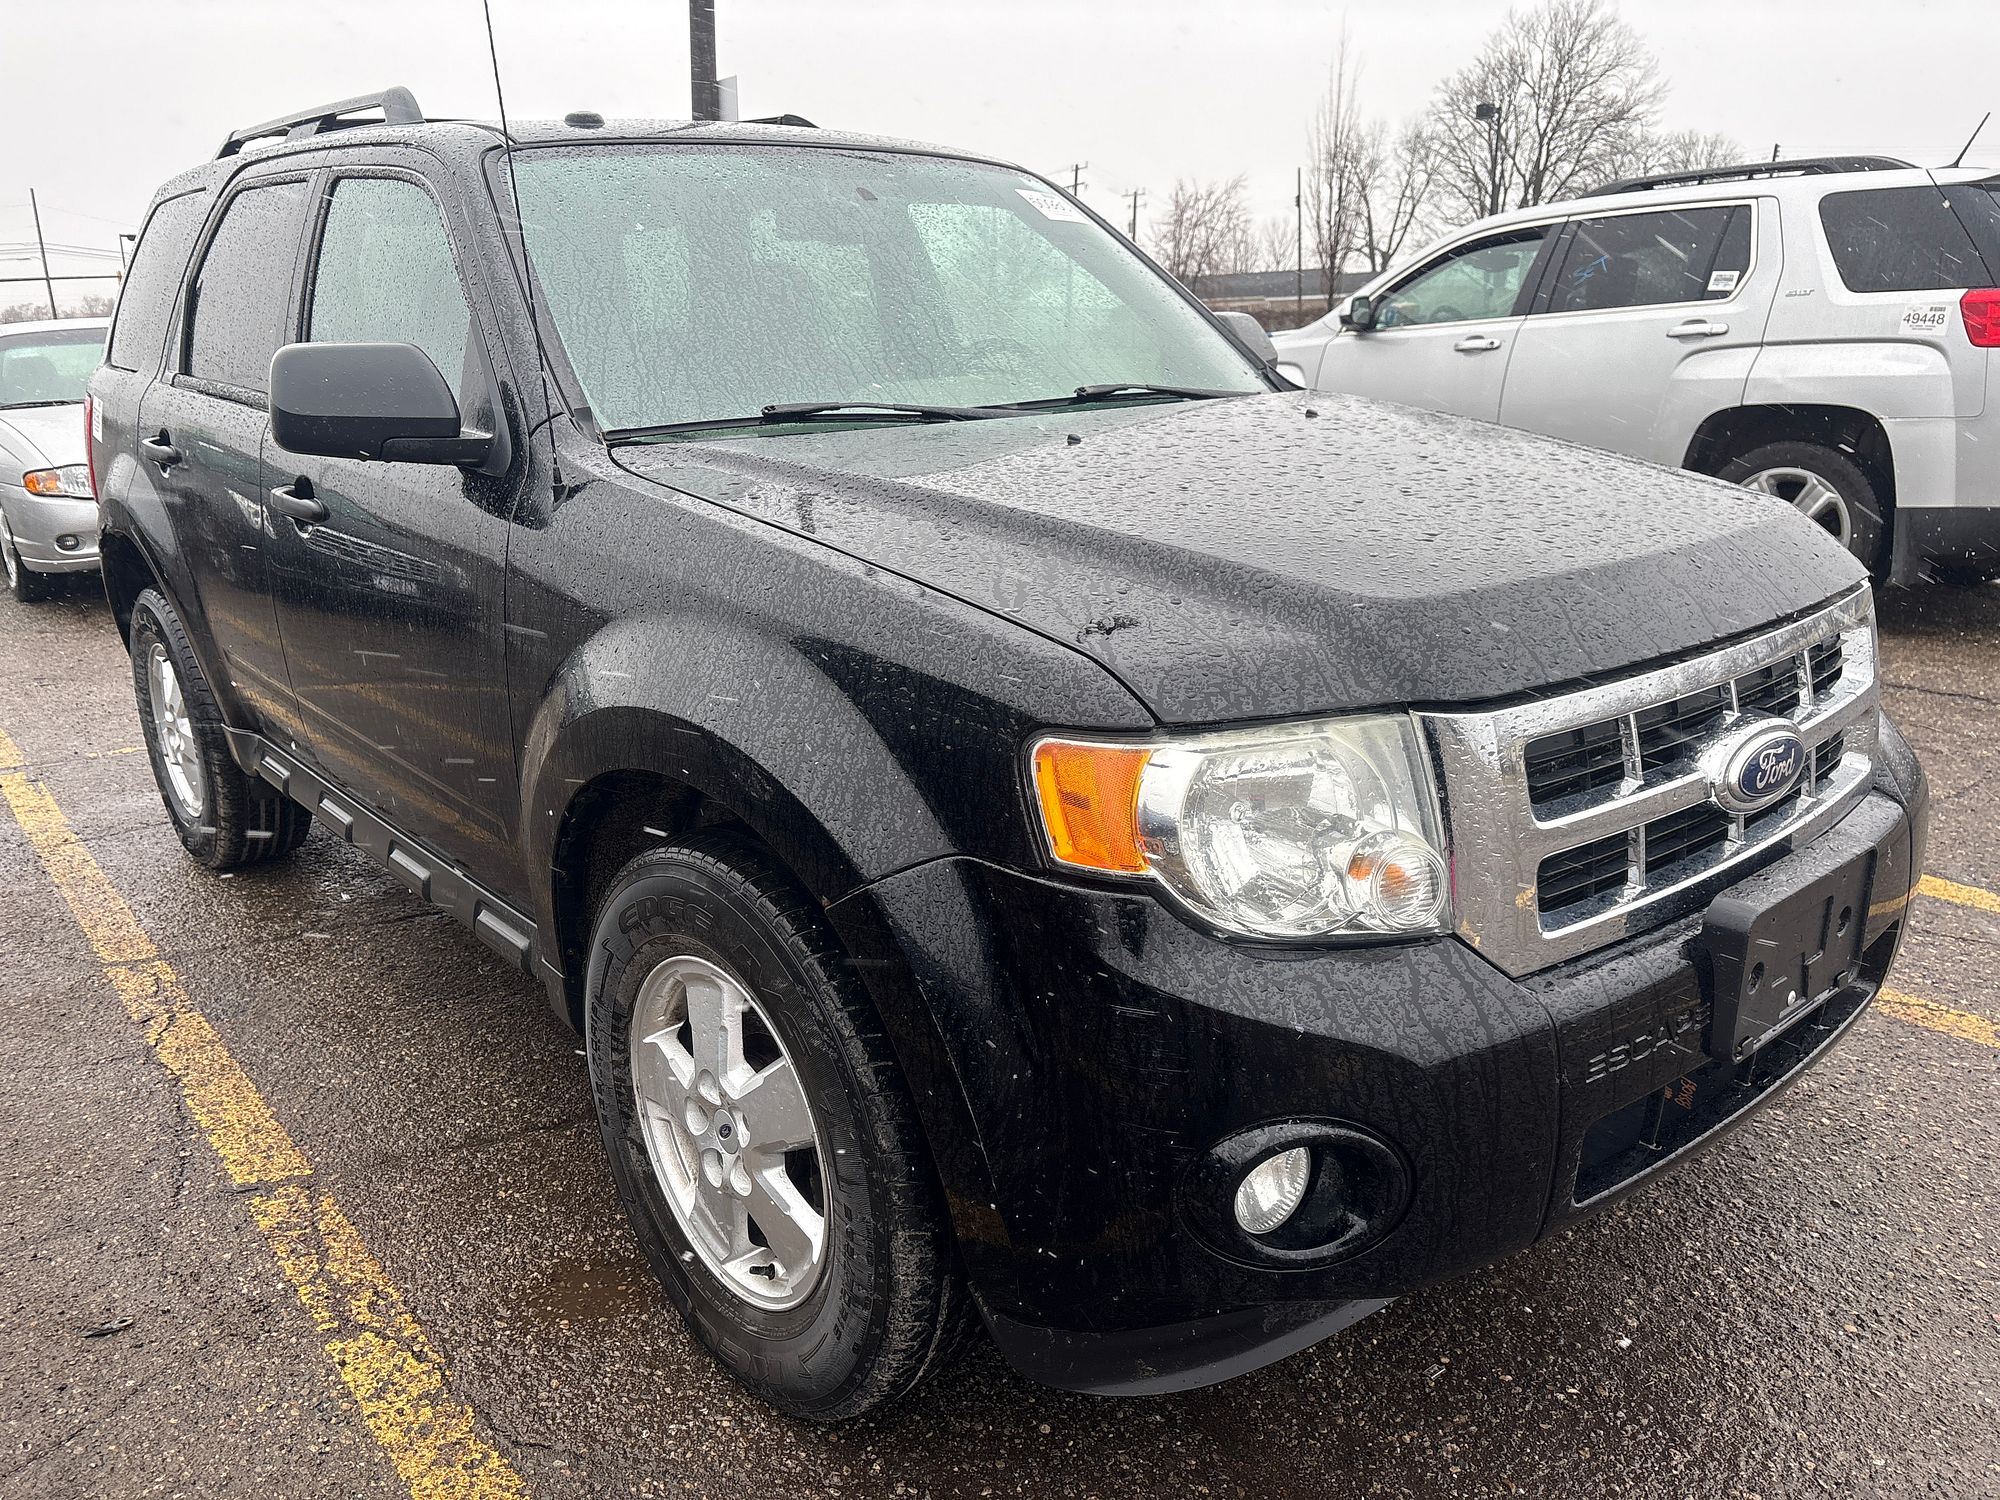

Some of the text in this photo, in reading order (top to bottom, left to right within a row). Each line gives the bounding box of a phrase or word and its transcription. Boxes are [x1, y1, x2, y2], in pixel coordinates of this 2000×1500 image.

[1903, 312, 1946, 325] 49448
[1756, 744, 1796, 790] Ford
[618, 895, 714, 934] EDGE
[1585, 1002, 1711, 1084] ESCAPE
